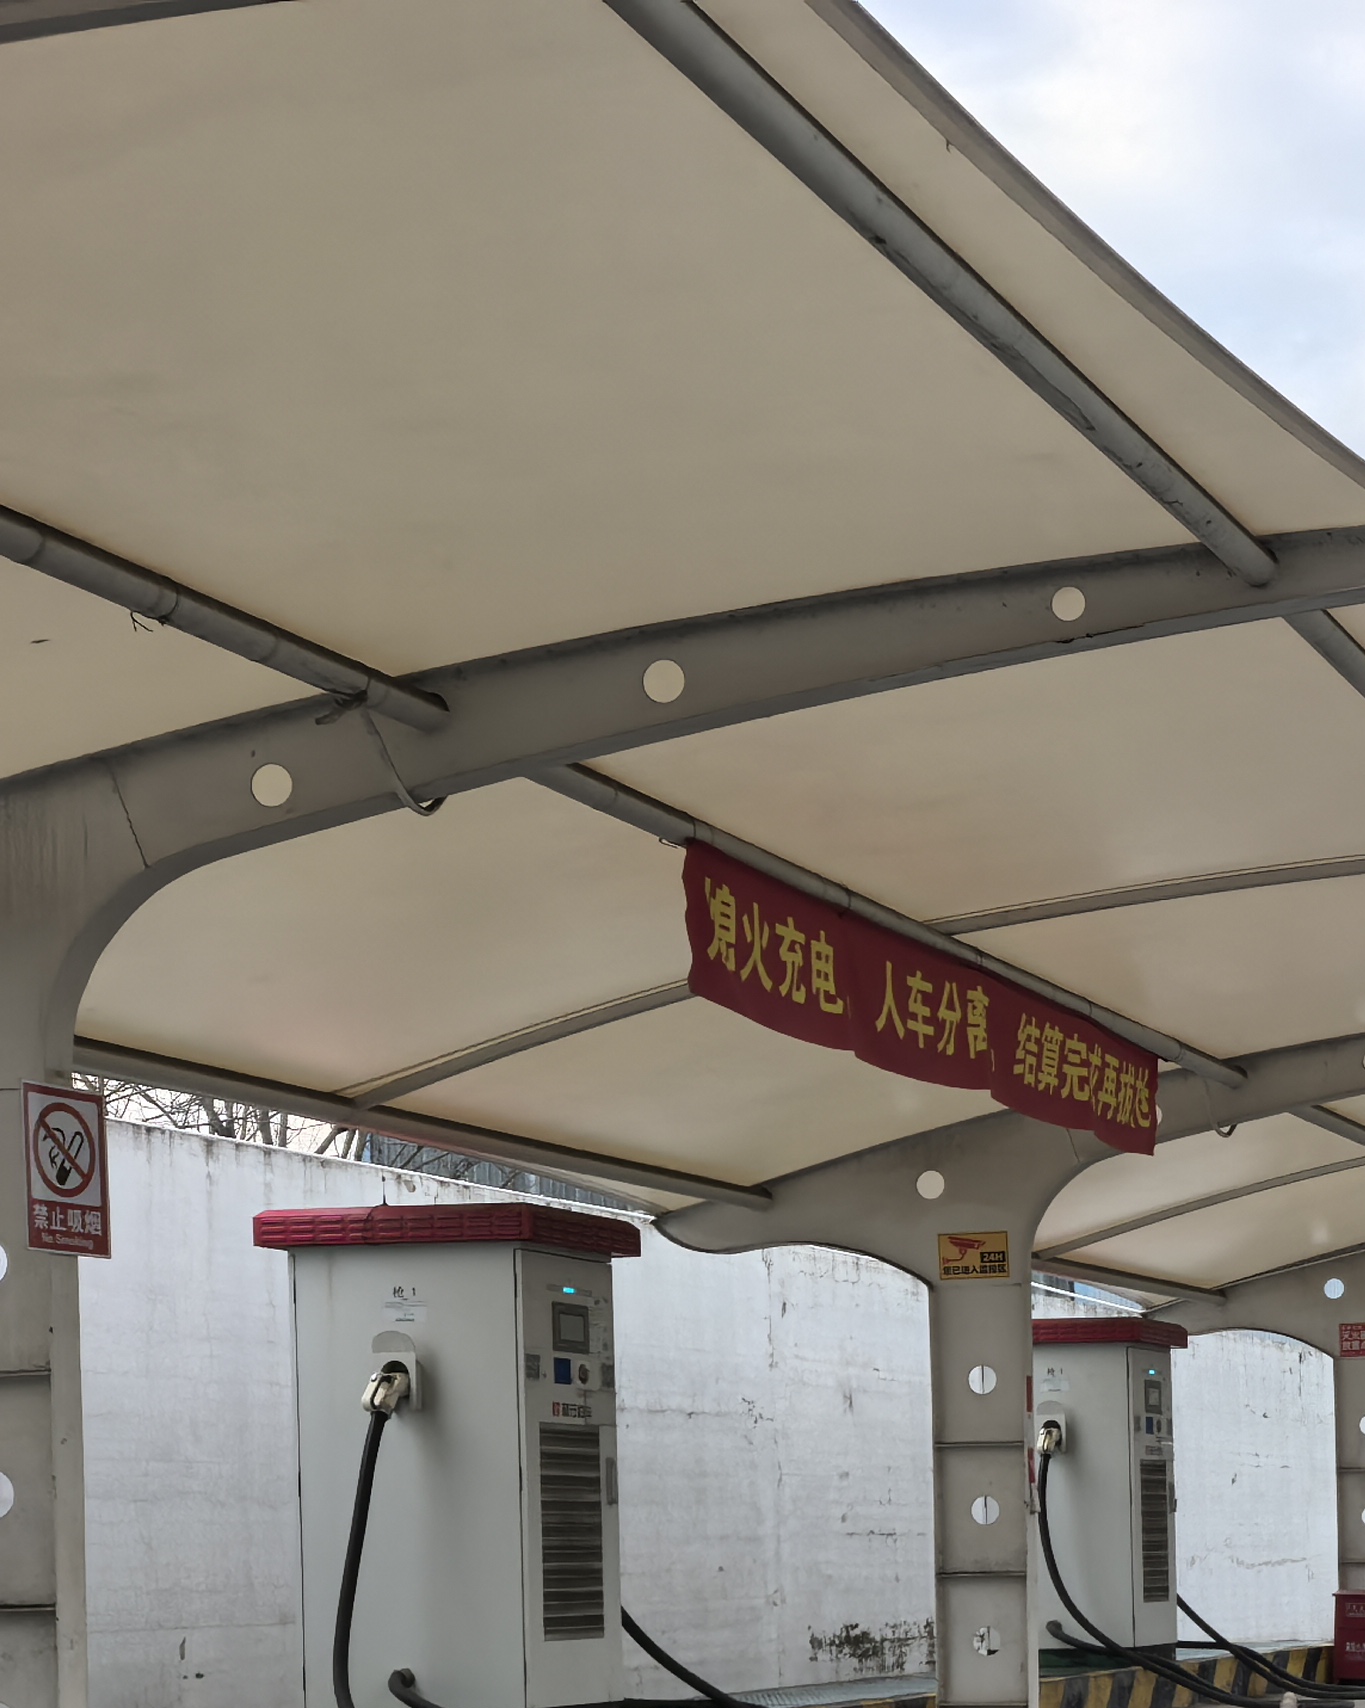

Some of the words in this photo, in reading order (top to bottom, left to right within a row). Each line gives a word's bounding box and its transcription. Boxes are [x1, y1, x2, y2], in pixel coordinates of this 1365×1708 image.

[33, 1203, 102, 1237] 禁止吸烟
[982, 1252, 1005, 1262] 24H
